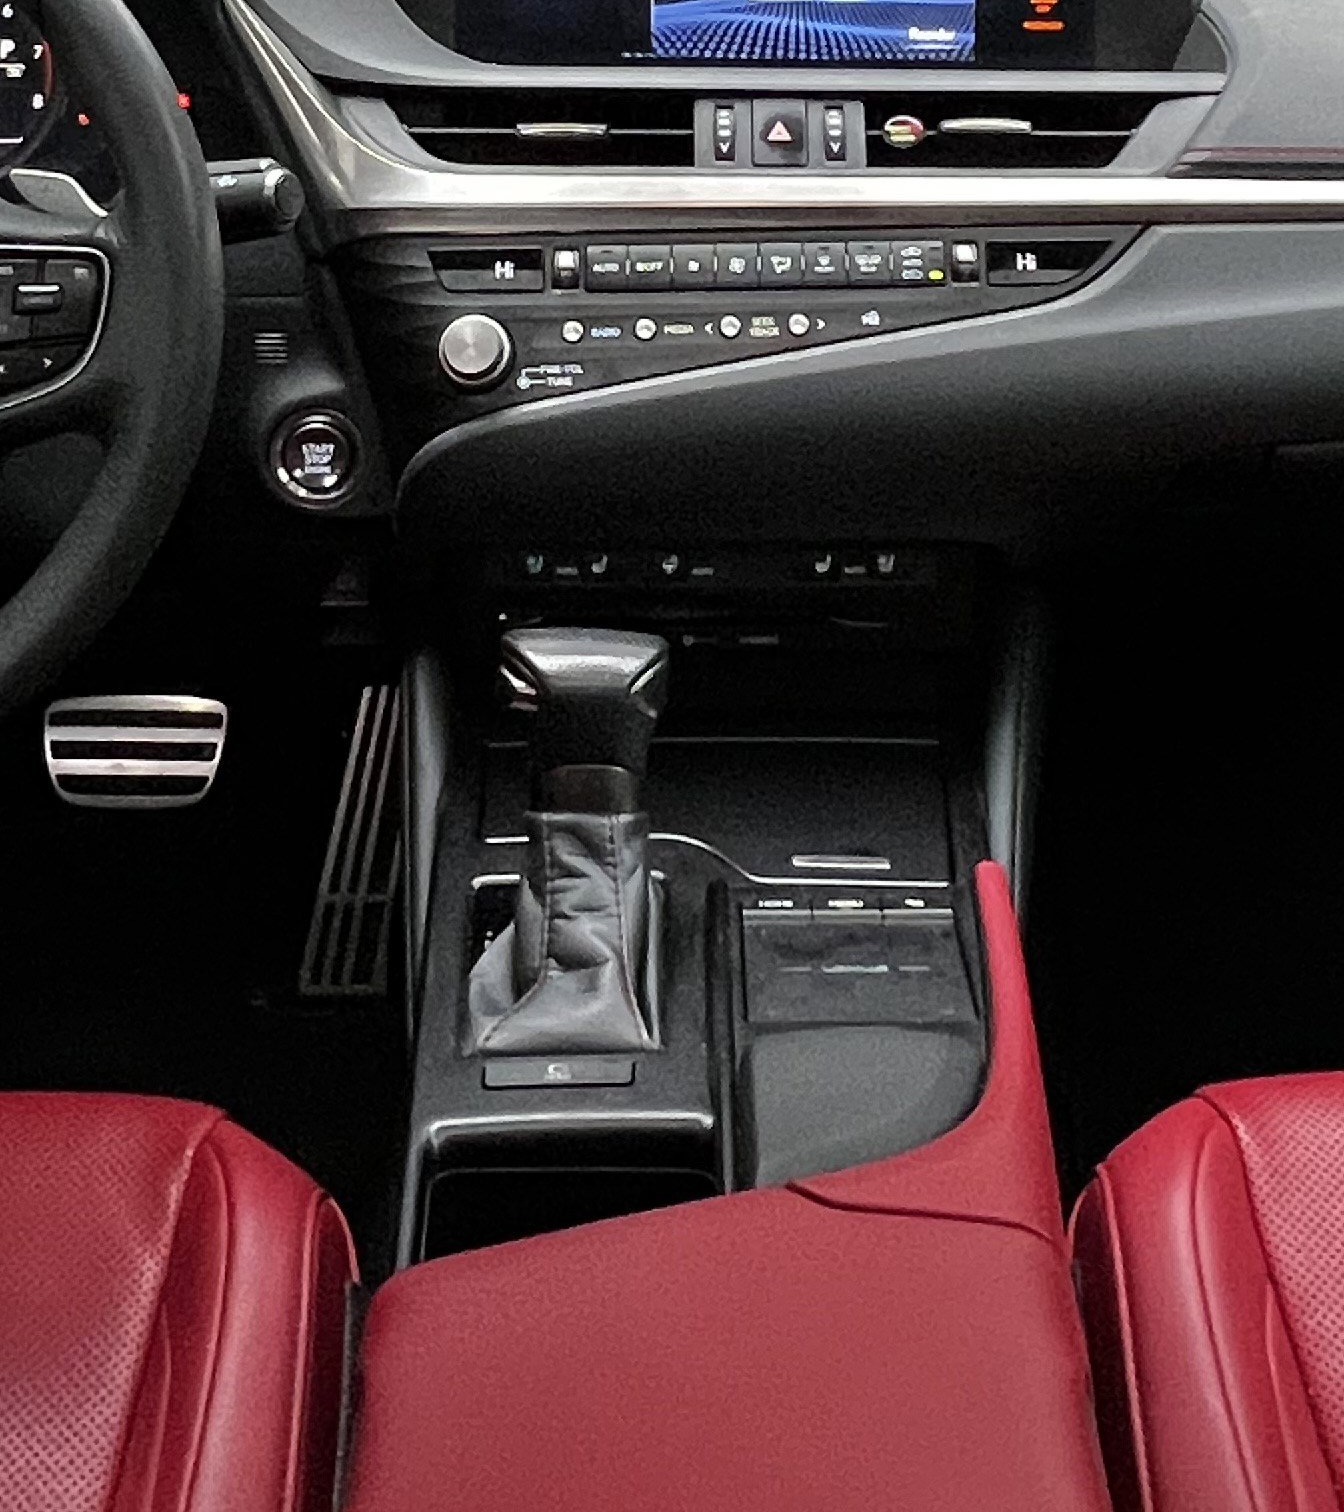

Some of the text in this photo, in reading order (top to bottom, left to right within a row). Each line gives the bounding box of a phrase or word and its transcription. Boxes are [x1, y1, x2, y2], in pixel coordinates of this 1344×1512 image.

[1, 2, 14, 18] 6
[32, 43, 44, 59] 7
[493, 259, 516, 280] Hi
[1015, 251, 1038, 272] Hi
[301, 442, 336, 456] START
[304, 453, 333, 465] STOP
